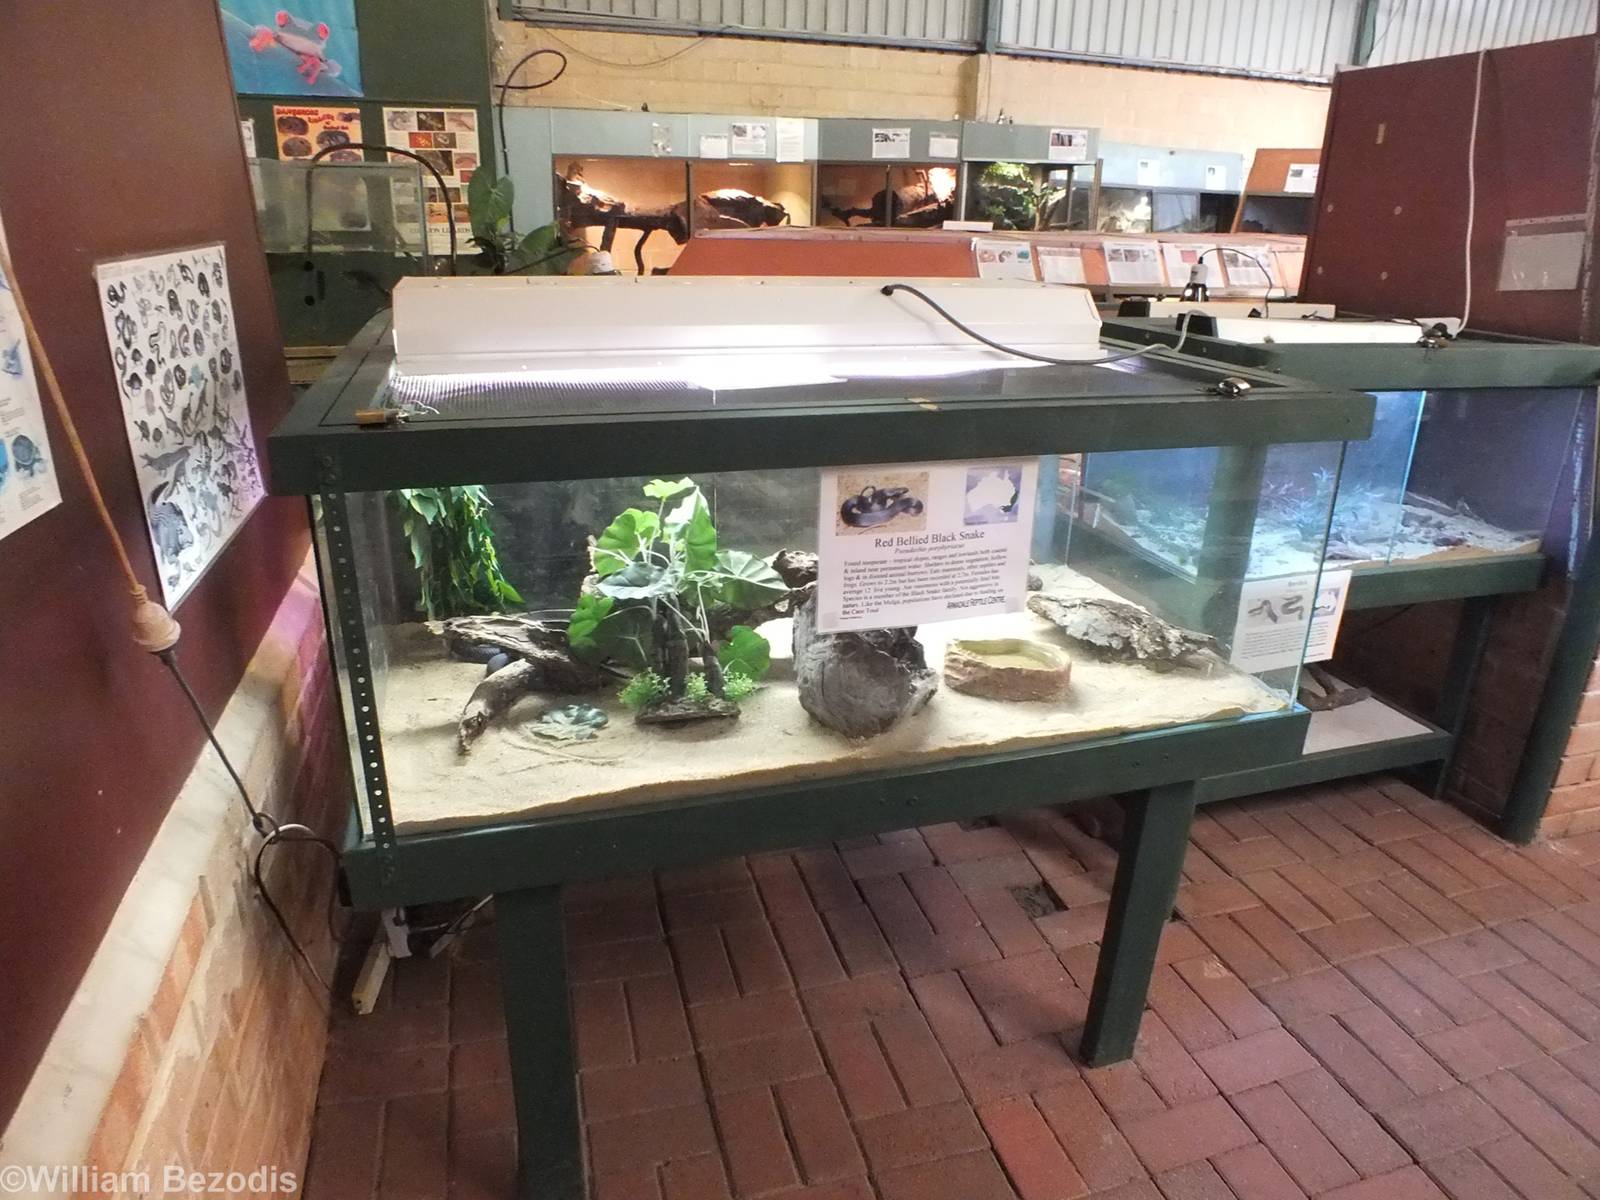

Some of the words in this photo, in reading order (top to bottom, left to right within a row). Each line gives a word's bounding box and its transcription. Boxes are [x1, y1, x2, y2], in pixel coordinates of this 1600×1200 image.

[874, 538, 893, 548] Red
[896, 536, 929, 546] Bellied
[931, 533, 956, 543] Black
[960, 530, 985, 540] Snake
